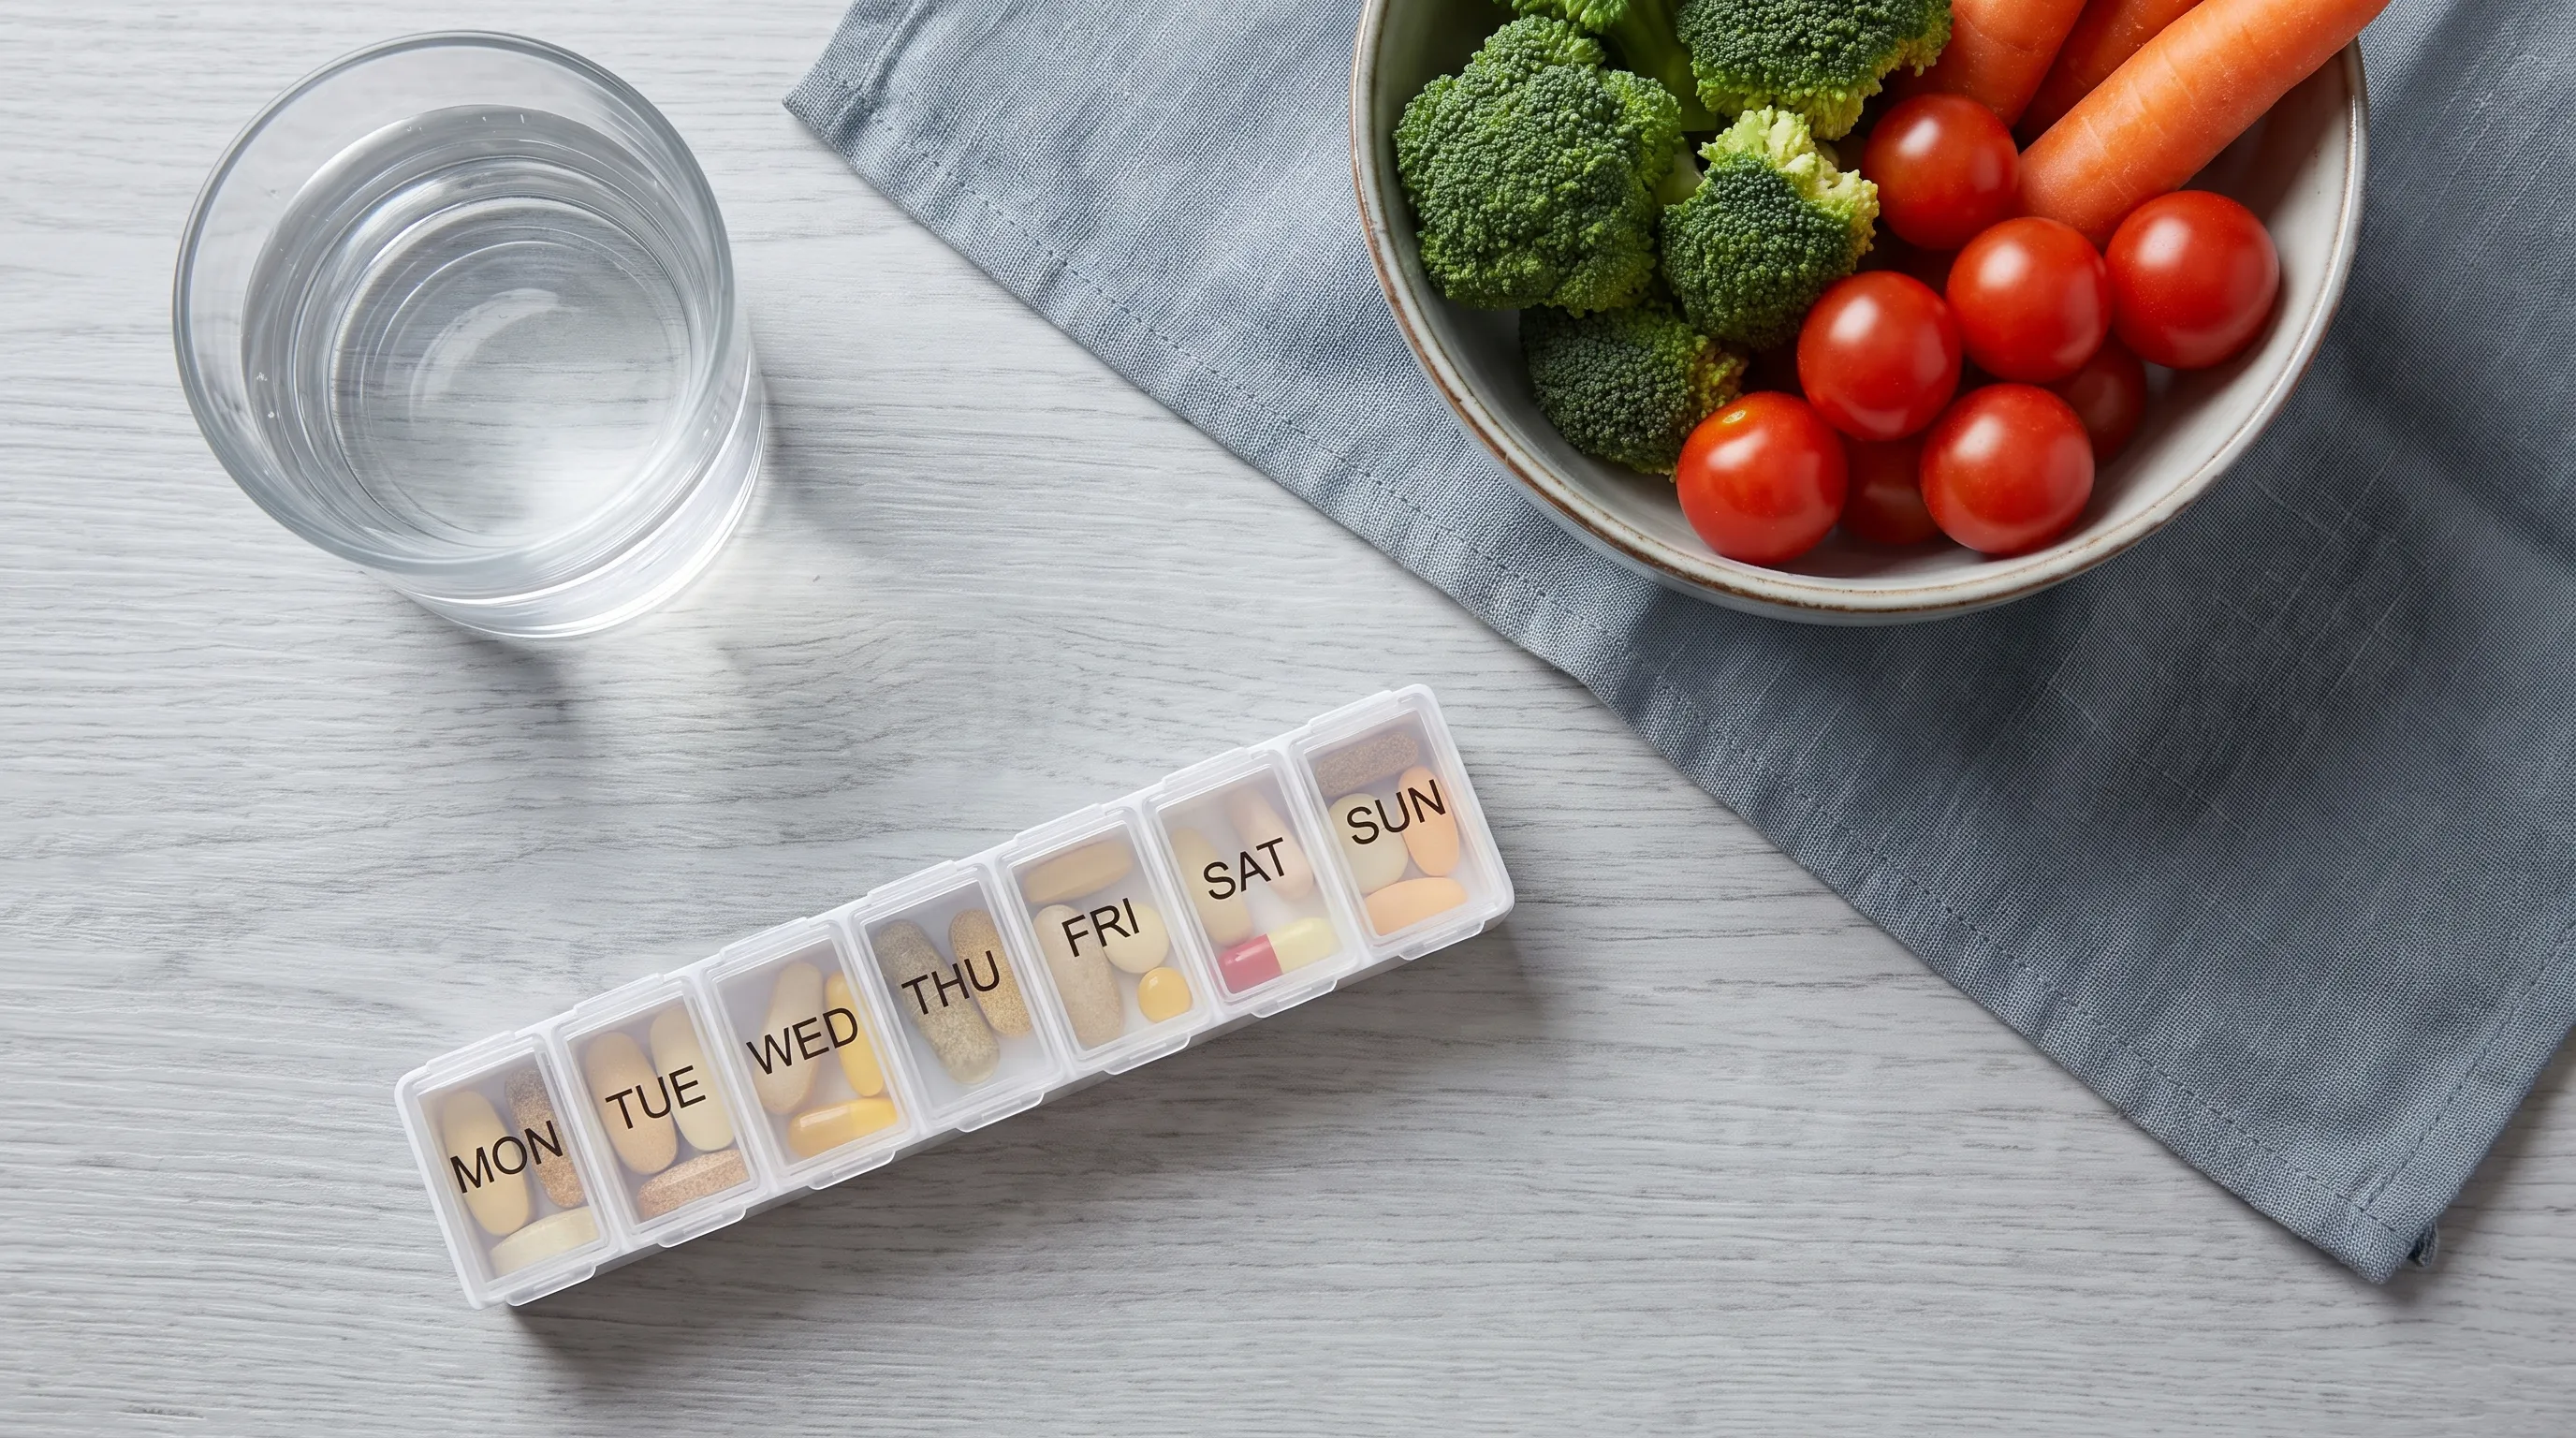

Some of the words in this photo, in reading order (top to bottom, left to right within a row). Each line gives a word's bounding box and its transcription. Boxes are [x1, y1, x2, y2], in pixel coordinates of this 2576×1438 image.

[1347, 779, 1446, 845] SUN
[1203, 837, 1285, 900] SAT
[1061, 897, 1140, 958] FRI
[900, 950, 1000, 1016] THU
[745, 1007, 858, 1075] WED
[605, 1064, 707, 1129] TUE
[449, 1120, 564, 1194] MON
